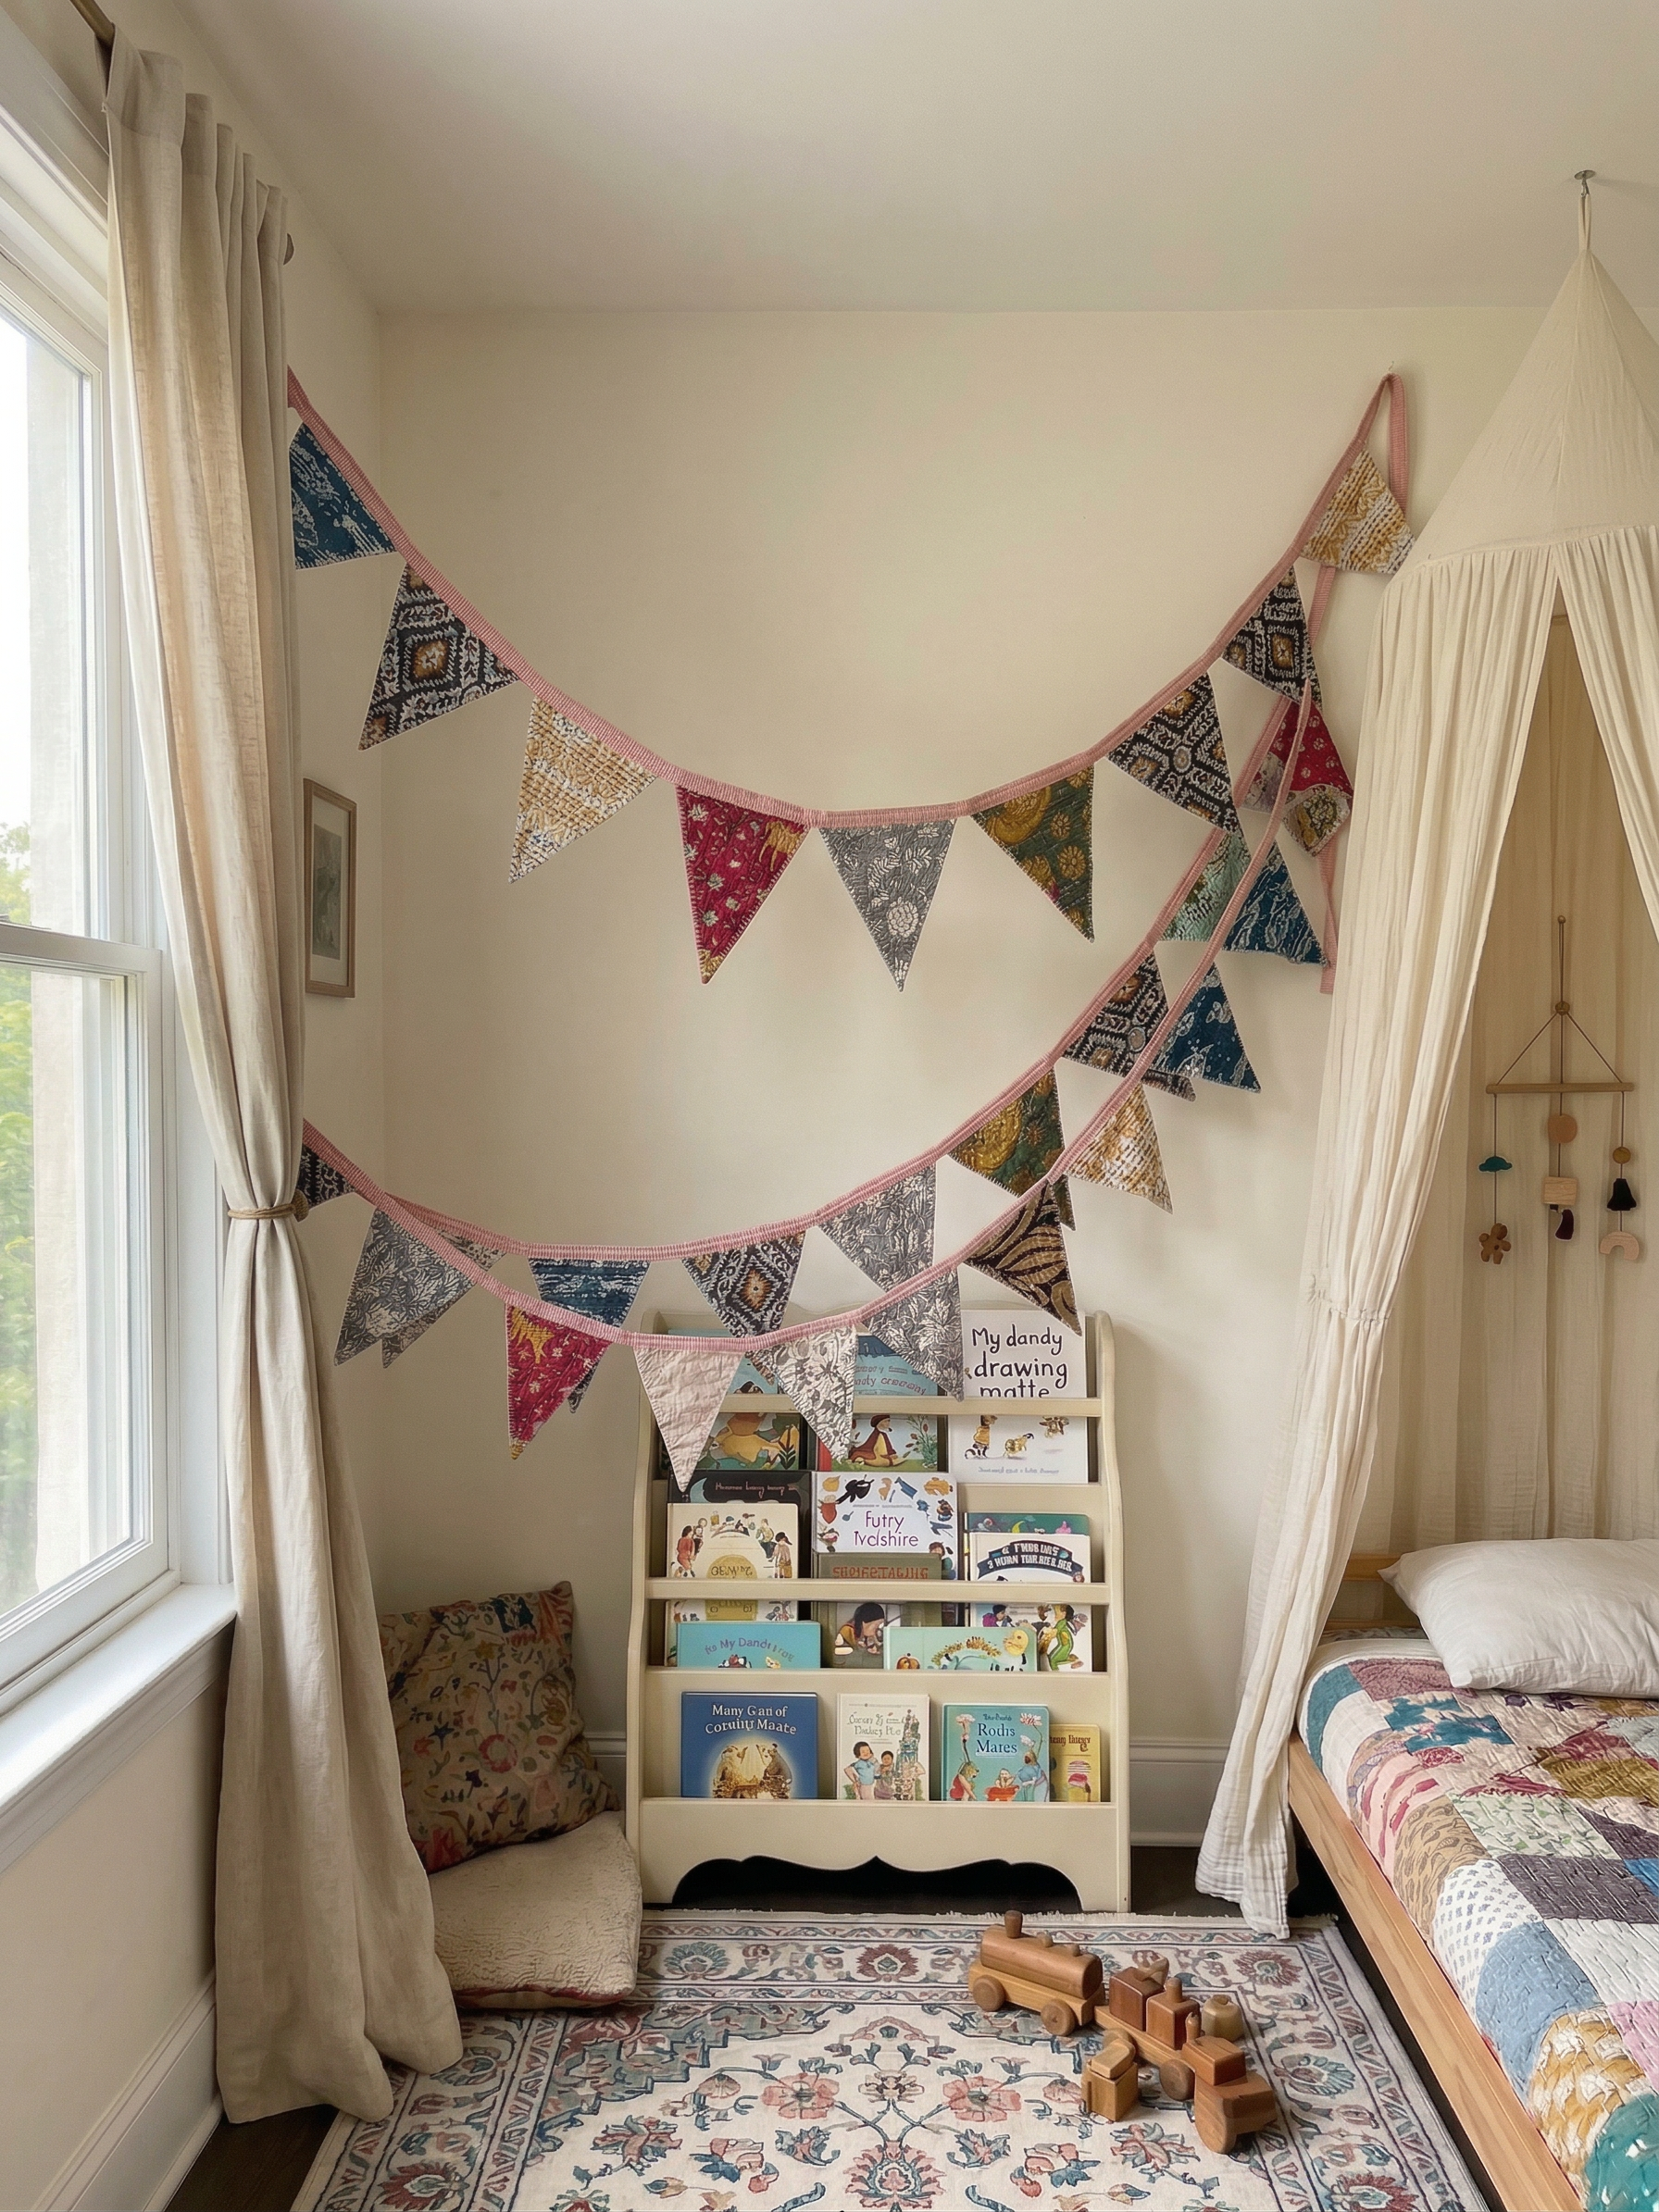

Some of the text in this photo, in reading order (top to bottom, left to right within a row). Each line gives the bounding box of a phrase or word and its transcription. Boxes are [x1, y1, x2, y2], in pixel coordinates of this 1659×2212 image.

[972, 1323, 1062, 1355] My dandy
[974, 1350, 1067, 1389] drawing
[980, 1378, 1050, 1398] matte
[712, 1704, 743, 1718] Many
[775, 1706, 788, 1717] of
[756, 1719, 797, 1734] Maate
